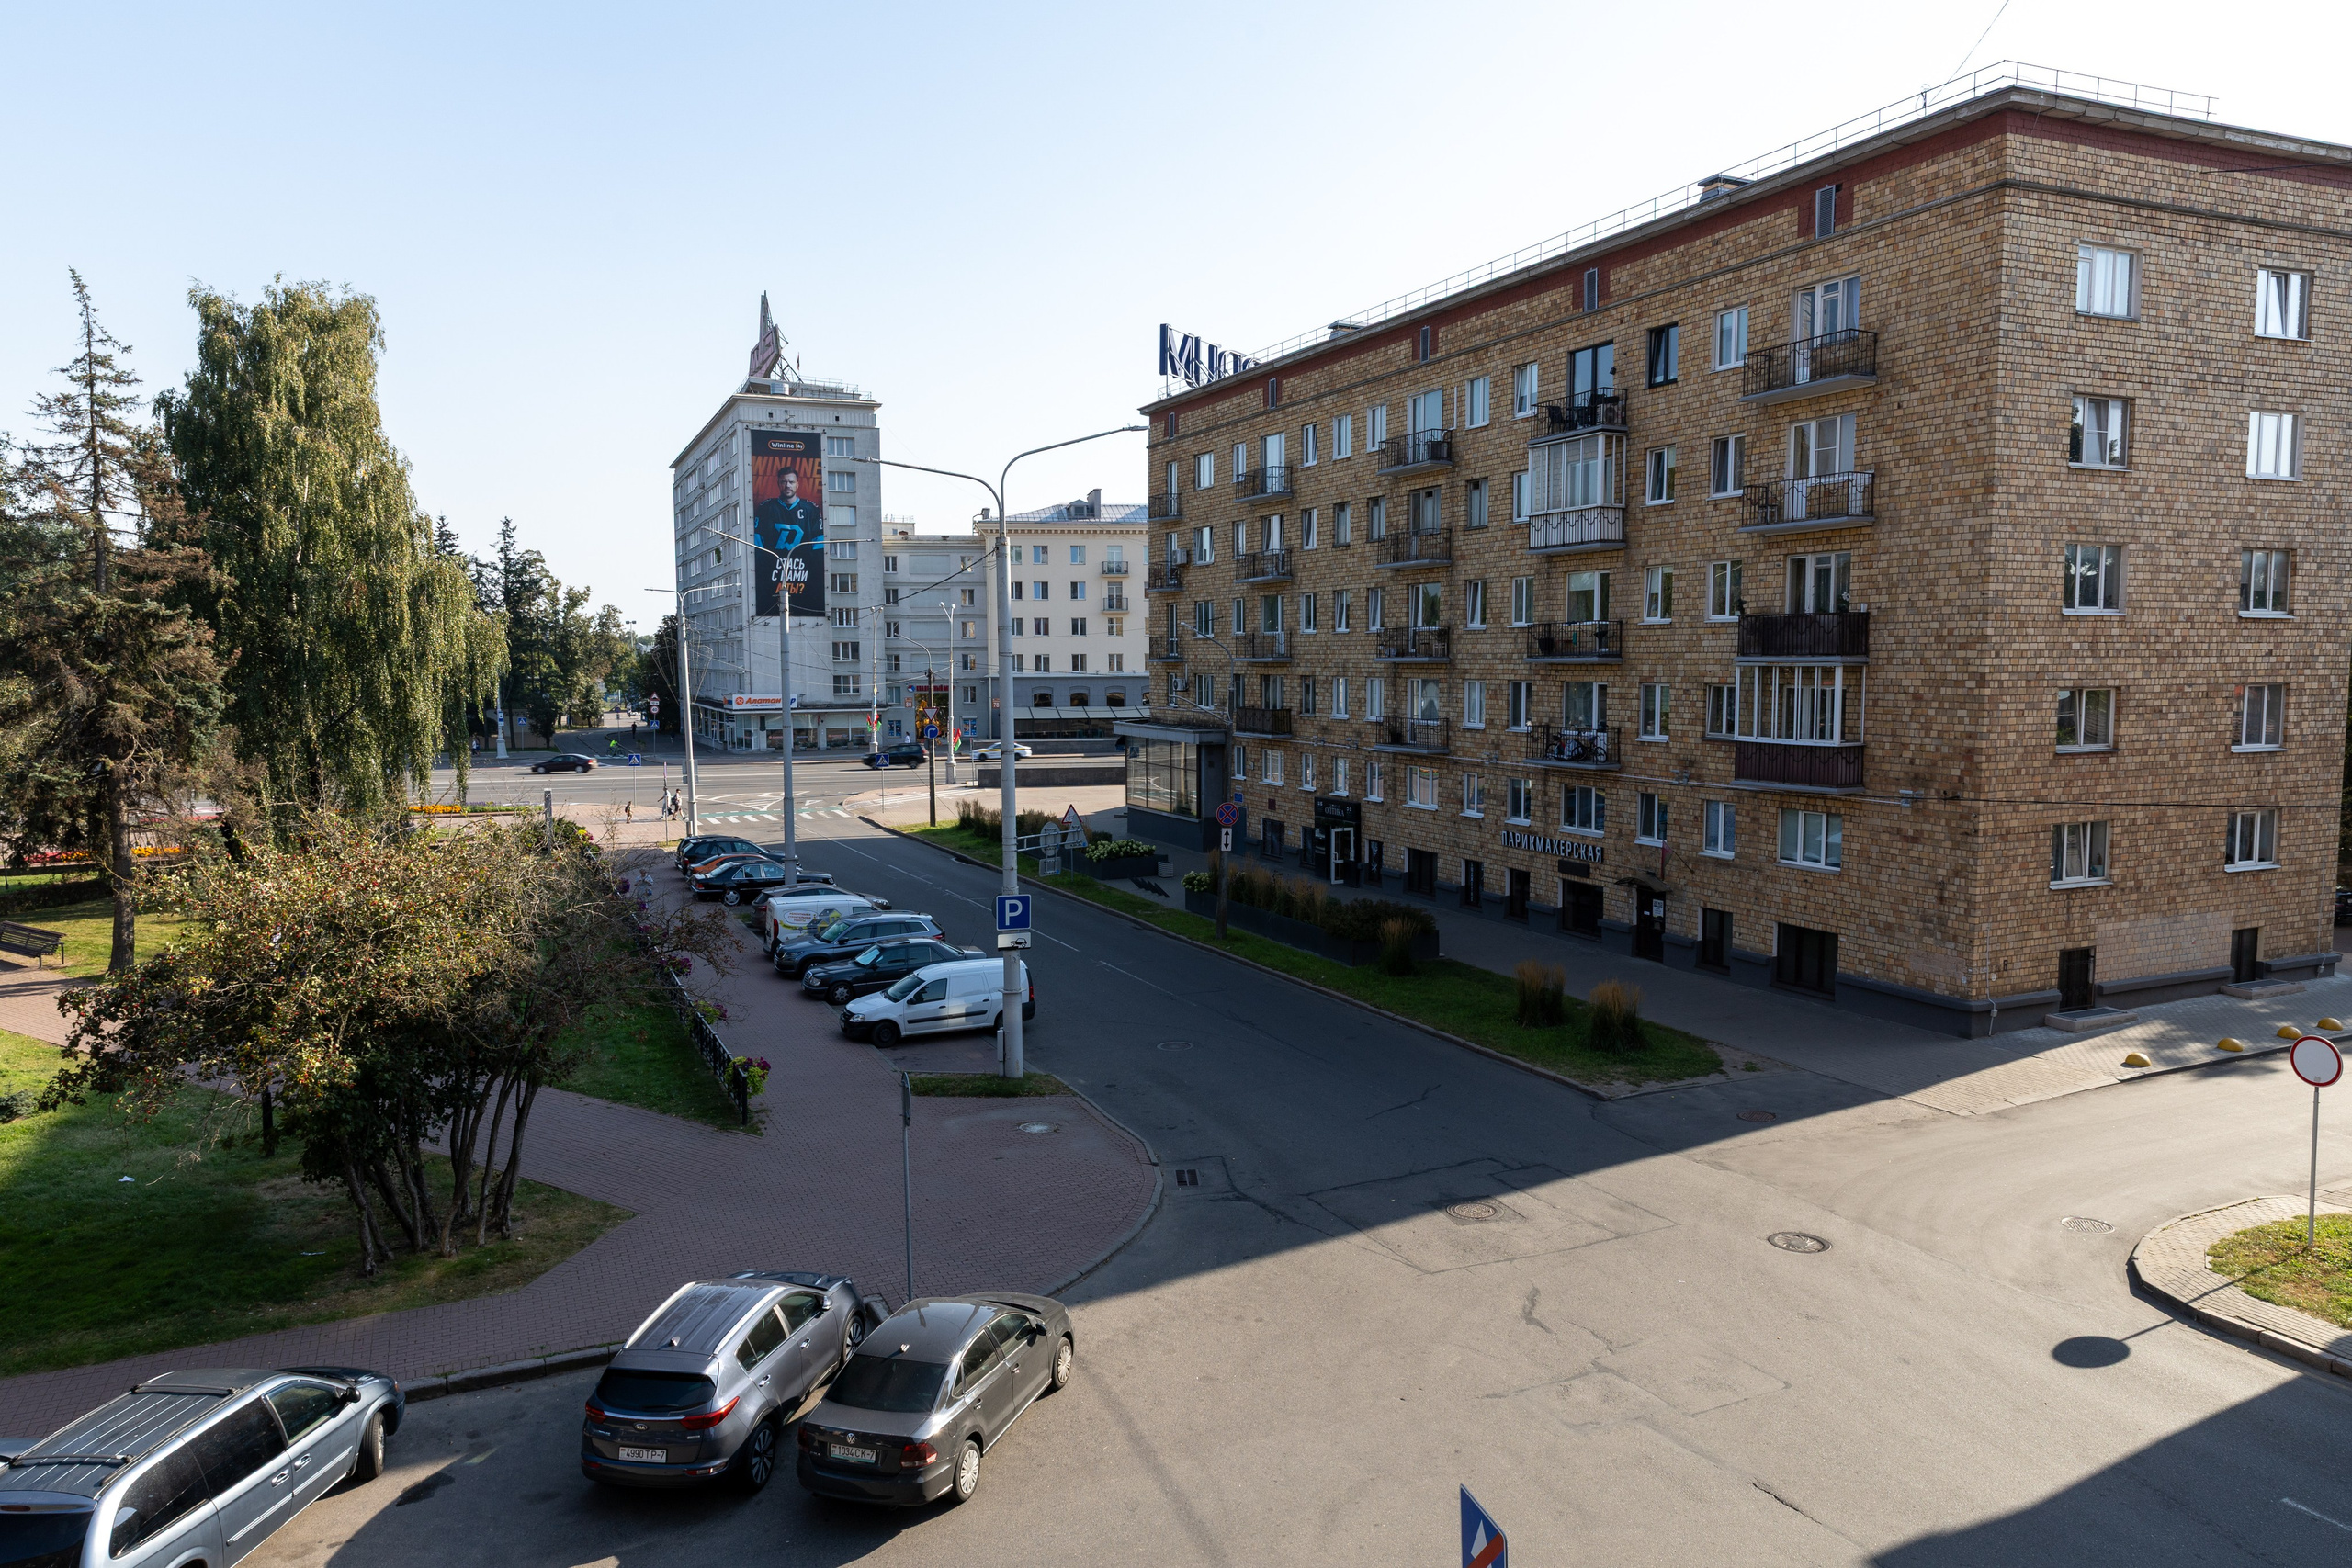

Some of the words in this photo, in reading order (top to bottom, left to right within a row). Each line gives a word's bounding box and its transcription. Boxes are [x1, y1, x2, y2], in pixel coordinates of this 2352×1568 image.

[776, 558, 805, 570] СТАСЬ
[1501, 830, 1601, 863] ПАРИКМАХЕРСКАЯ
[1005, 899, 1023, 926] P
[626, 1449, 643, 1459] 4990
[646, 1450, 665, 1460] TP-7
[838, 1446, 854, 1456] 1034
[854, 1447, 875, 1460] CK-7
